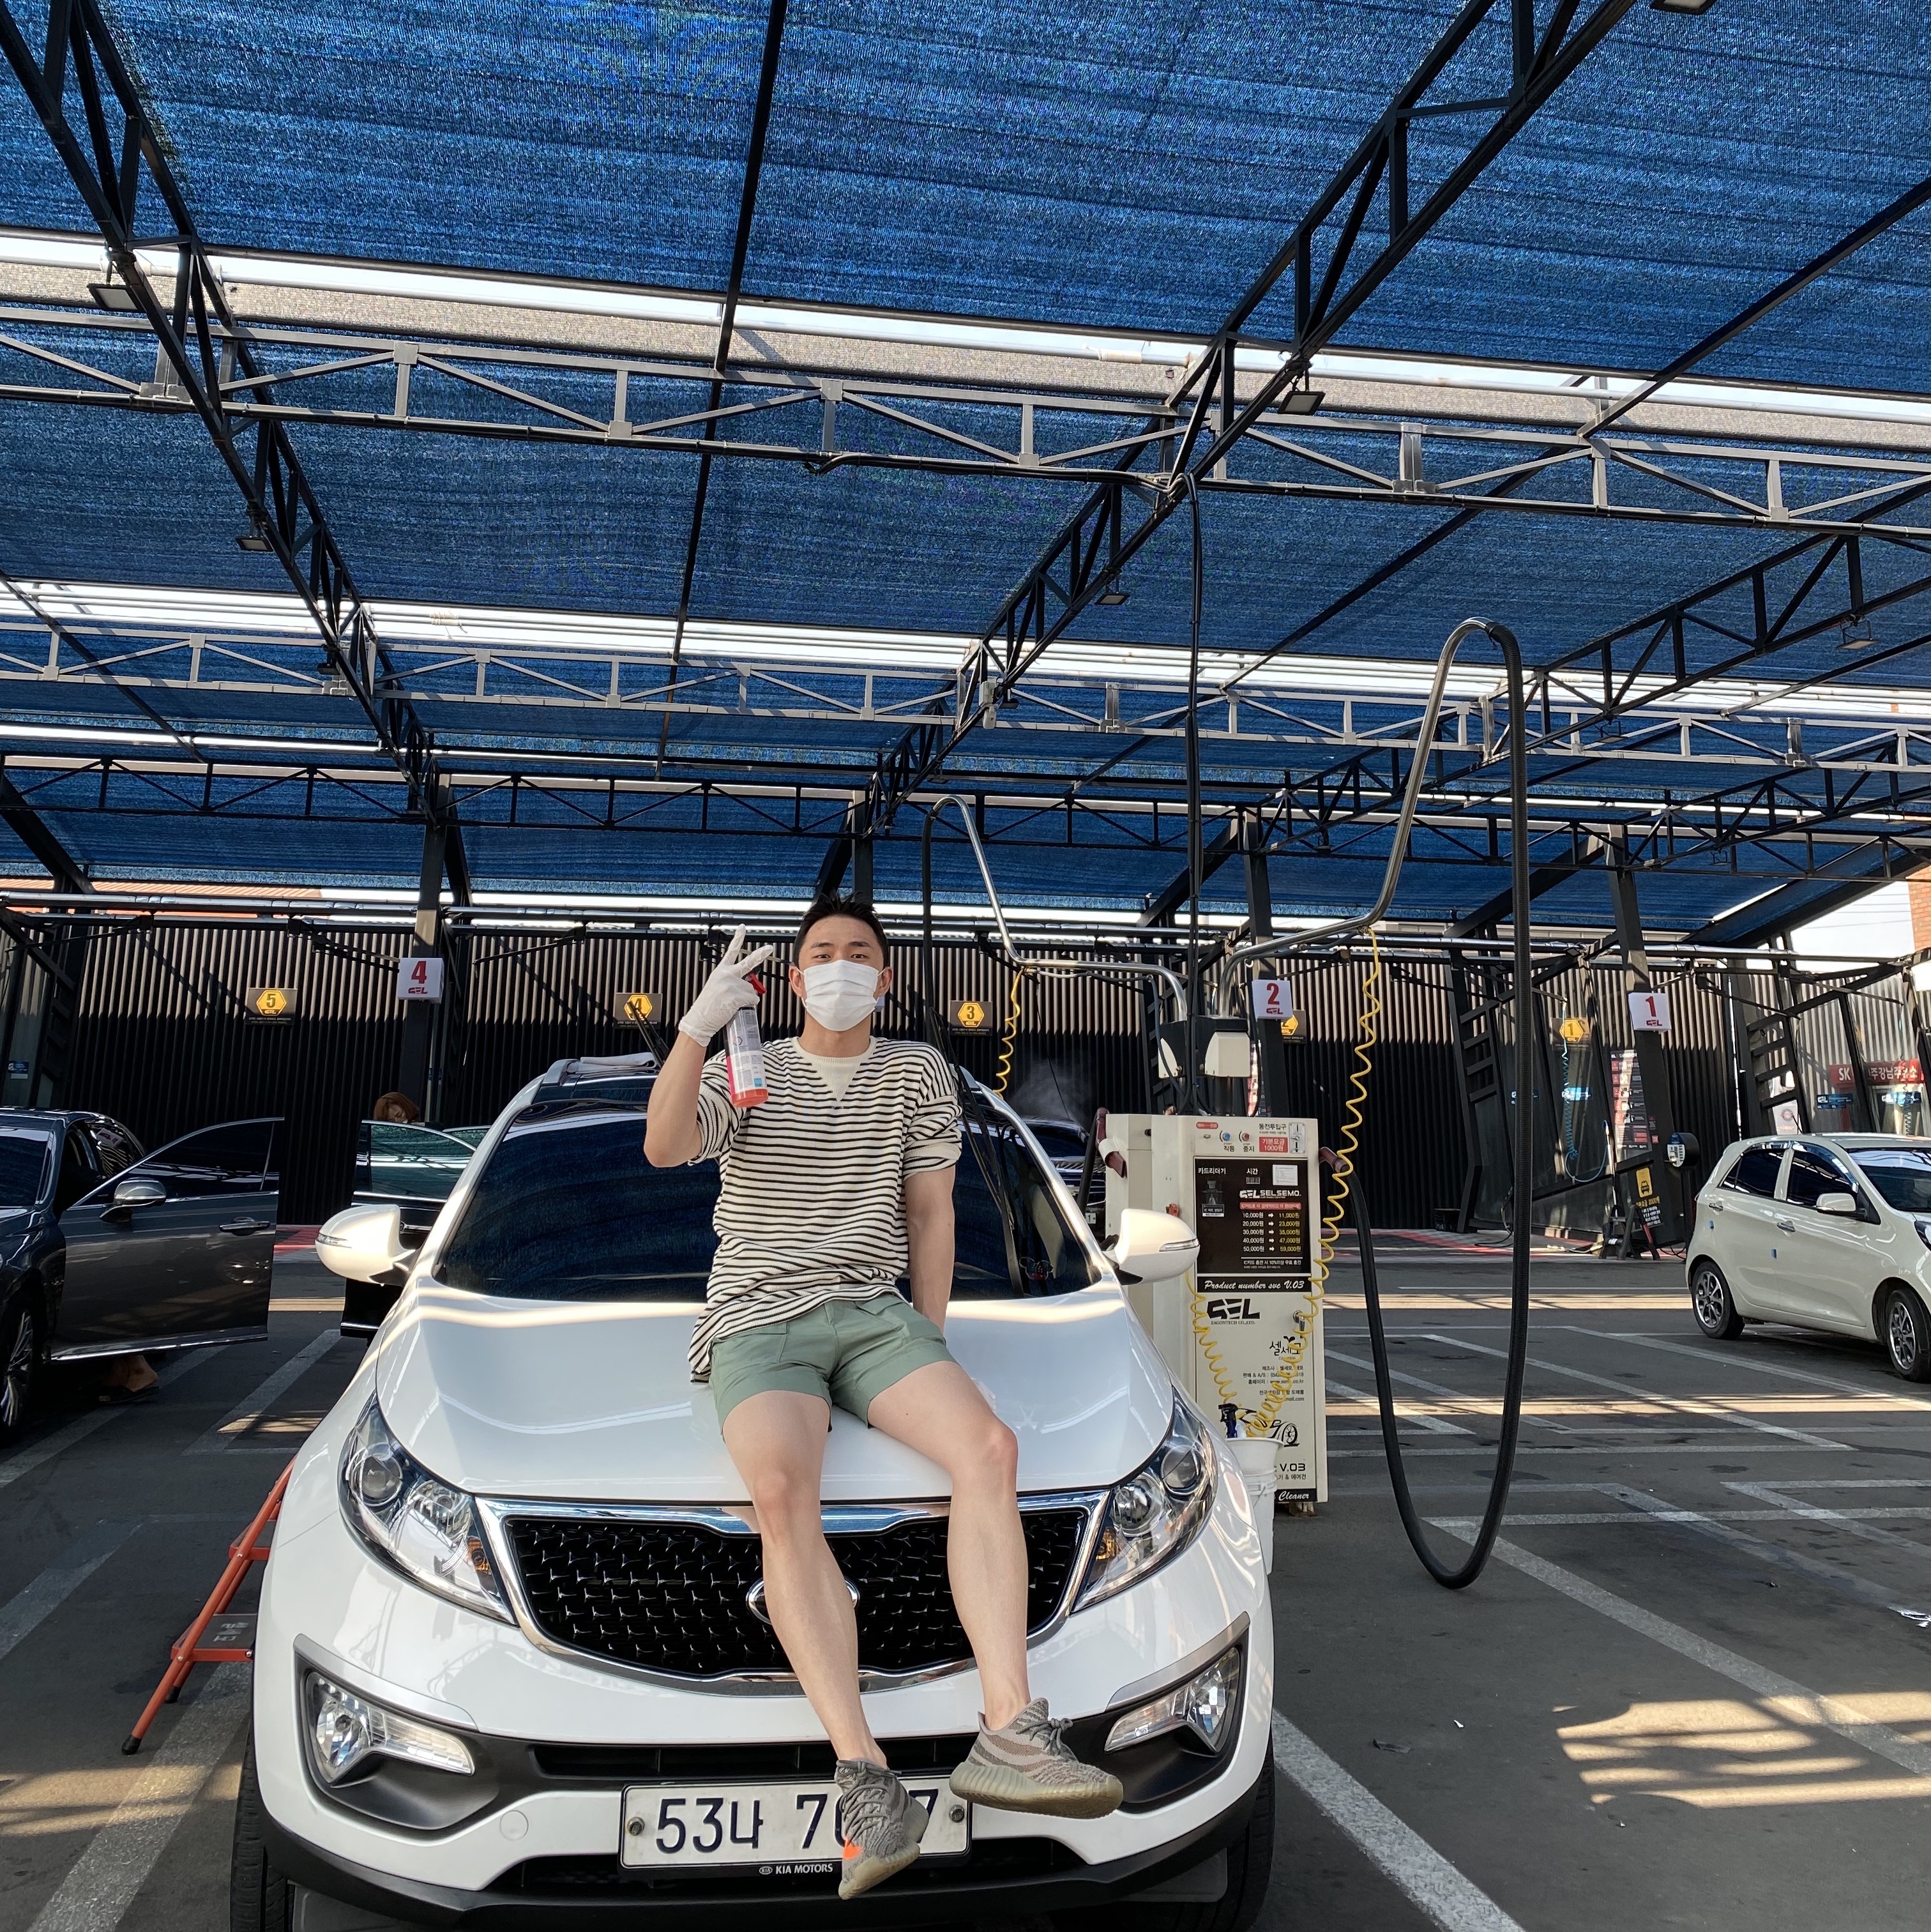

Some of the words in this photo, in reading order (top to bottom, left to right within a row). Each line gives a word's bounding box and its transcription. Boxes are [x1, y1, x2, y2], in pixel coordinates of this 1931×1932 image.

[411, 961, 427, 984] 4
[1266, 983, 1280, 1005] 2
[266, 994, 276, 1008] 5
[1646, 996, 1656, 1017] 1
[967, 1006, 974, 1019] 3
[1568, 1023, 1573, 1035] 1
[1838, 1068, 1851, 1081] SK
[1204, 1281, 1236, 1289] Product
[1238, 1281, 1266, 1289] number
[1284, 1281, 1305, 1289] V.03
[1279, 1463, 1306, 1472] V.03
[1278, 1491, 1310, 1501] Cleaner
[656, 1797, 764, 1854] 53나
[796, 1789, 939, 1850] 77
[775, 1866, 792, 1875] KIA
[794, 1864, 833, 1873] MOTORS
